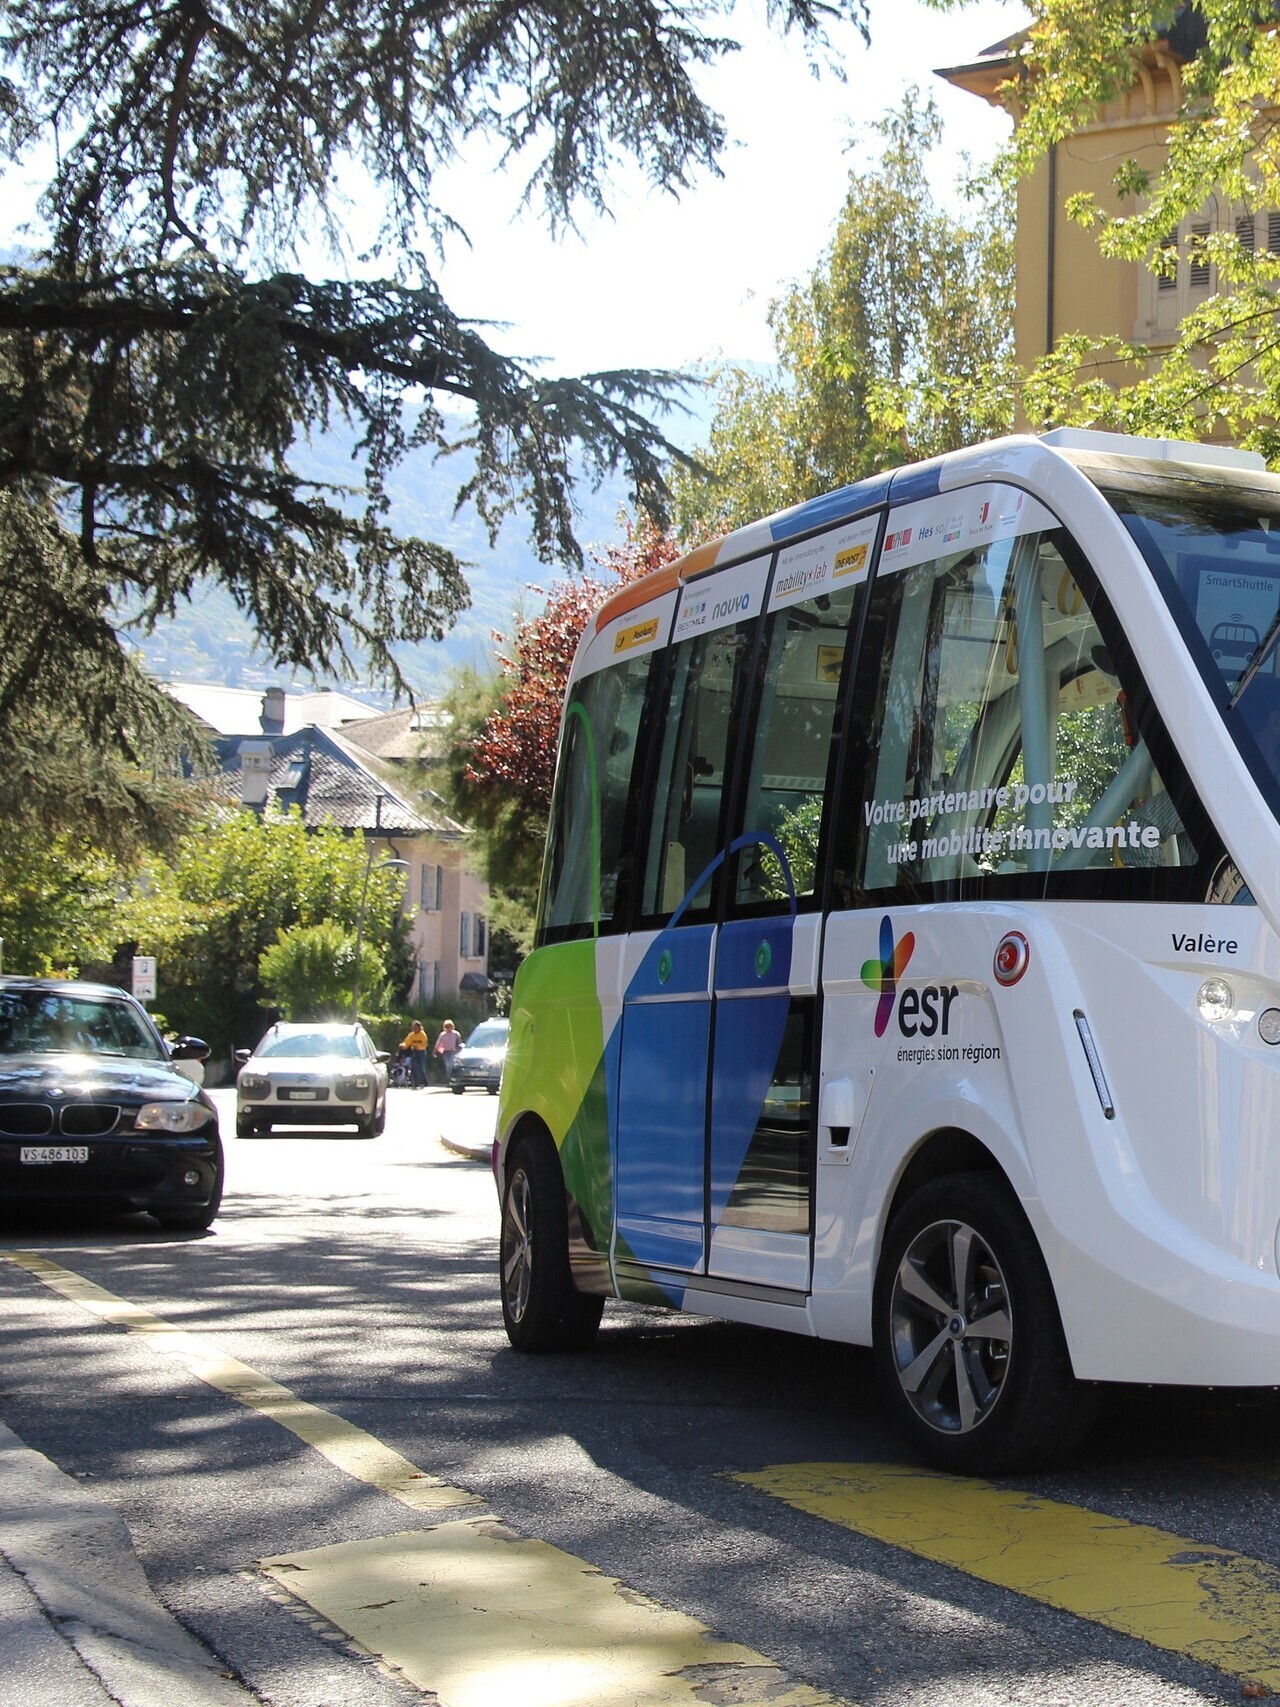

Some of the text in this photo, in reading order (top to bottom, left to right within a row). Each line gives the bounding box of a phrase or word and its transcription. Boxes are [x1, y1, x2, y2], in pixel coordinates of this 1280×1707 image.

[844, 552, 860, 566] POST
[1206, 574, 1274, 593] SmartShuttle
[863, 778, 1078, 827] Votre partenaire pour
[886, 820, 1161, 865] une mobilité innovante
[1170, 932, 1239, 955] Valère
[898, 984, 960, 1038] esr
[897, 1043, 1001, 1066] énergies sion région
